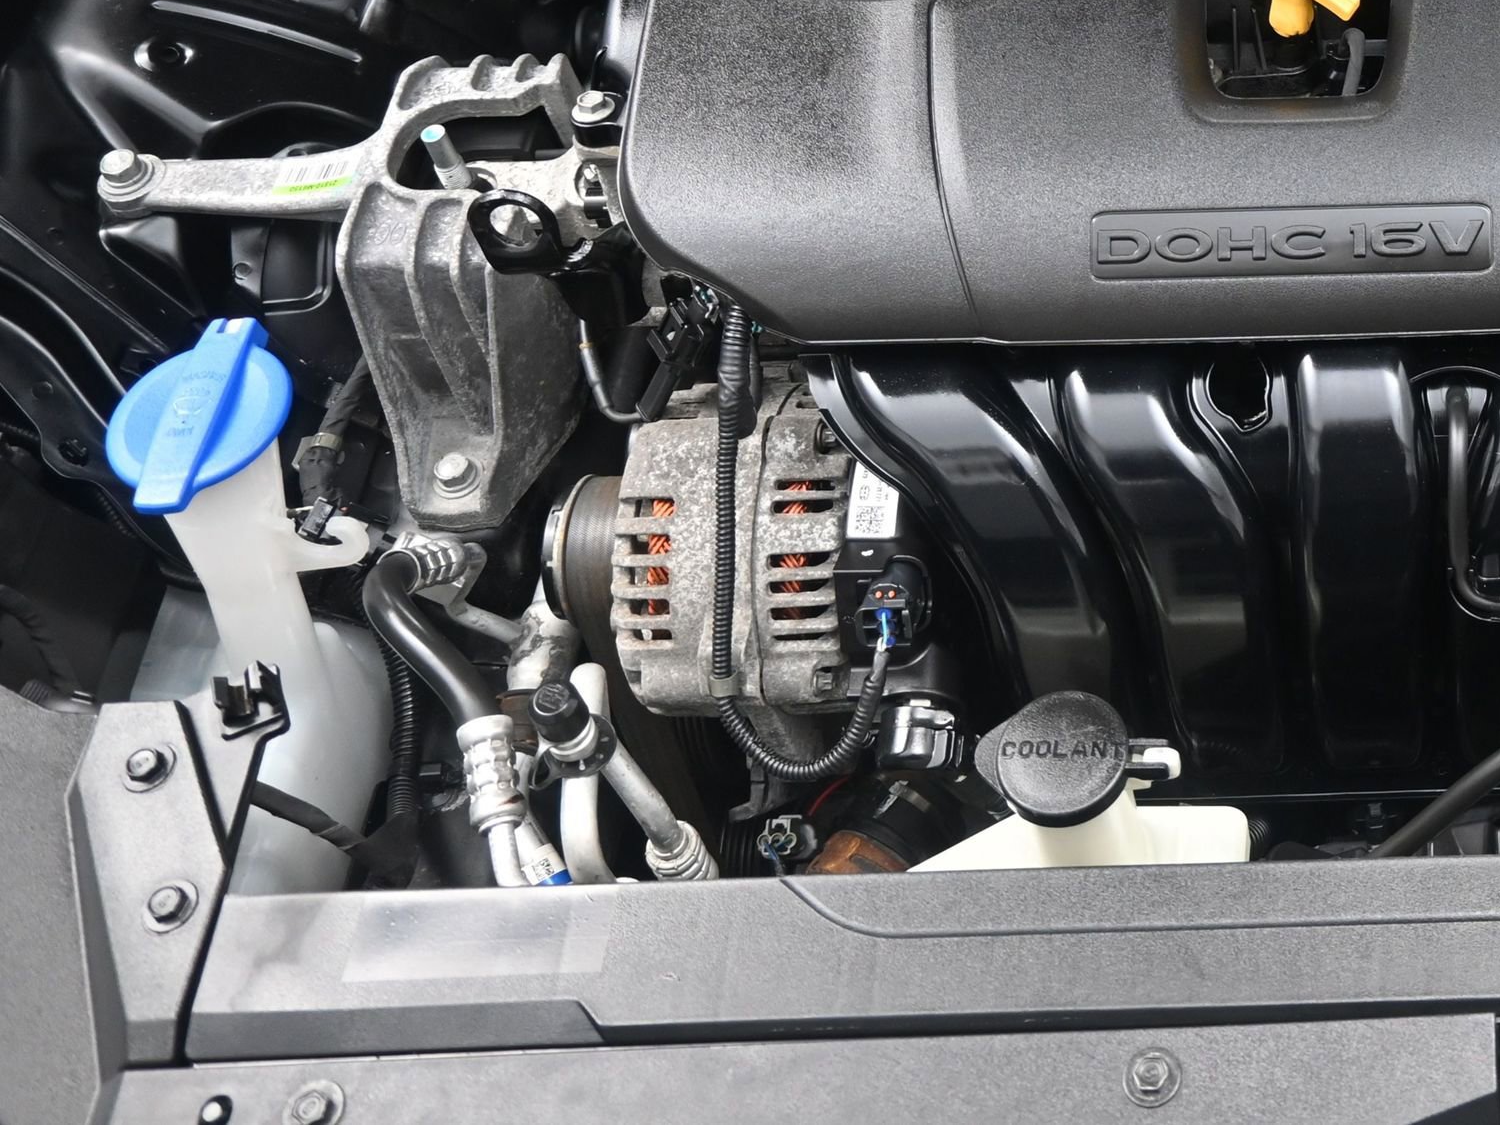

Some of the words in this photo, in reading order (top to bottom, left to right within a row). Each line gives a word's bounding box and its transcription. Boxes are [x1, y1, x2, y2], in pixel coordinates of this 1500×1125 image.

[1096, 224, 1327, 265] DOHC
[1349, 219, 1485, 259] 16V
[1001, 738, 1126, 761] COOLANT
